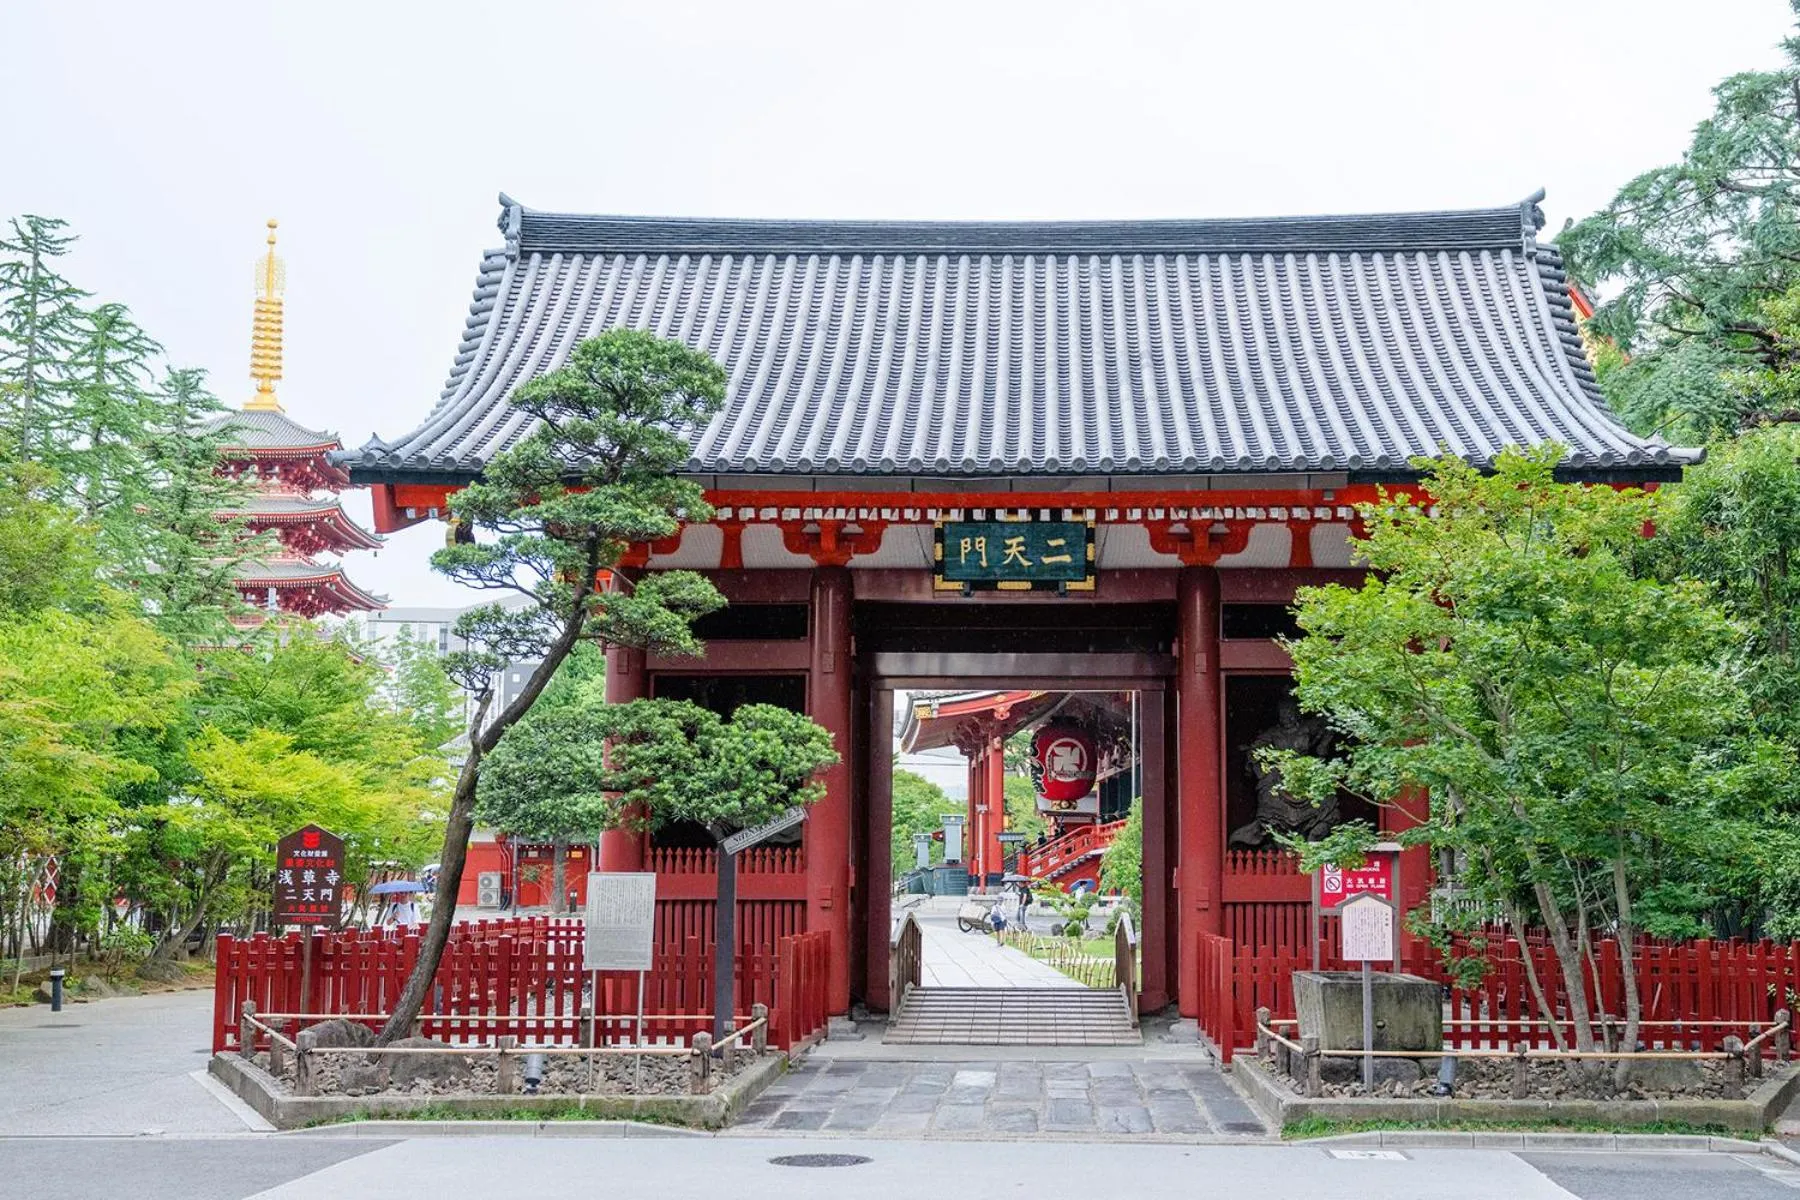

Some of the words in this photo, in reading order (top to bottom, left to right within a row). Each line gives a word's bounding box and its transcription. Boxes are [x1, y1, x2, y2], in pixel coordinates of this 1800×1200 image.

[278, 869, 341, 886] 浅草寺
[284, 888, 334, 901] 二天門
